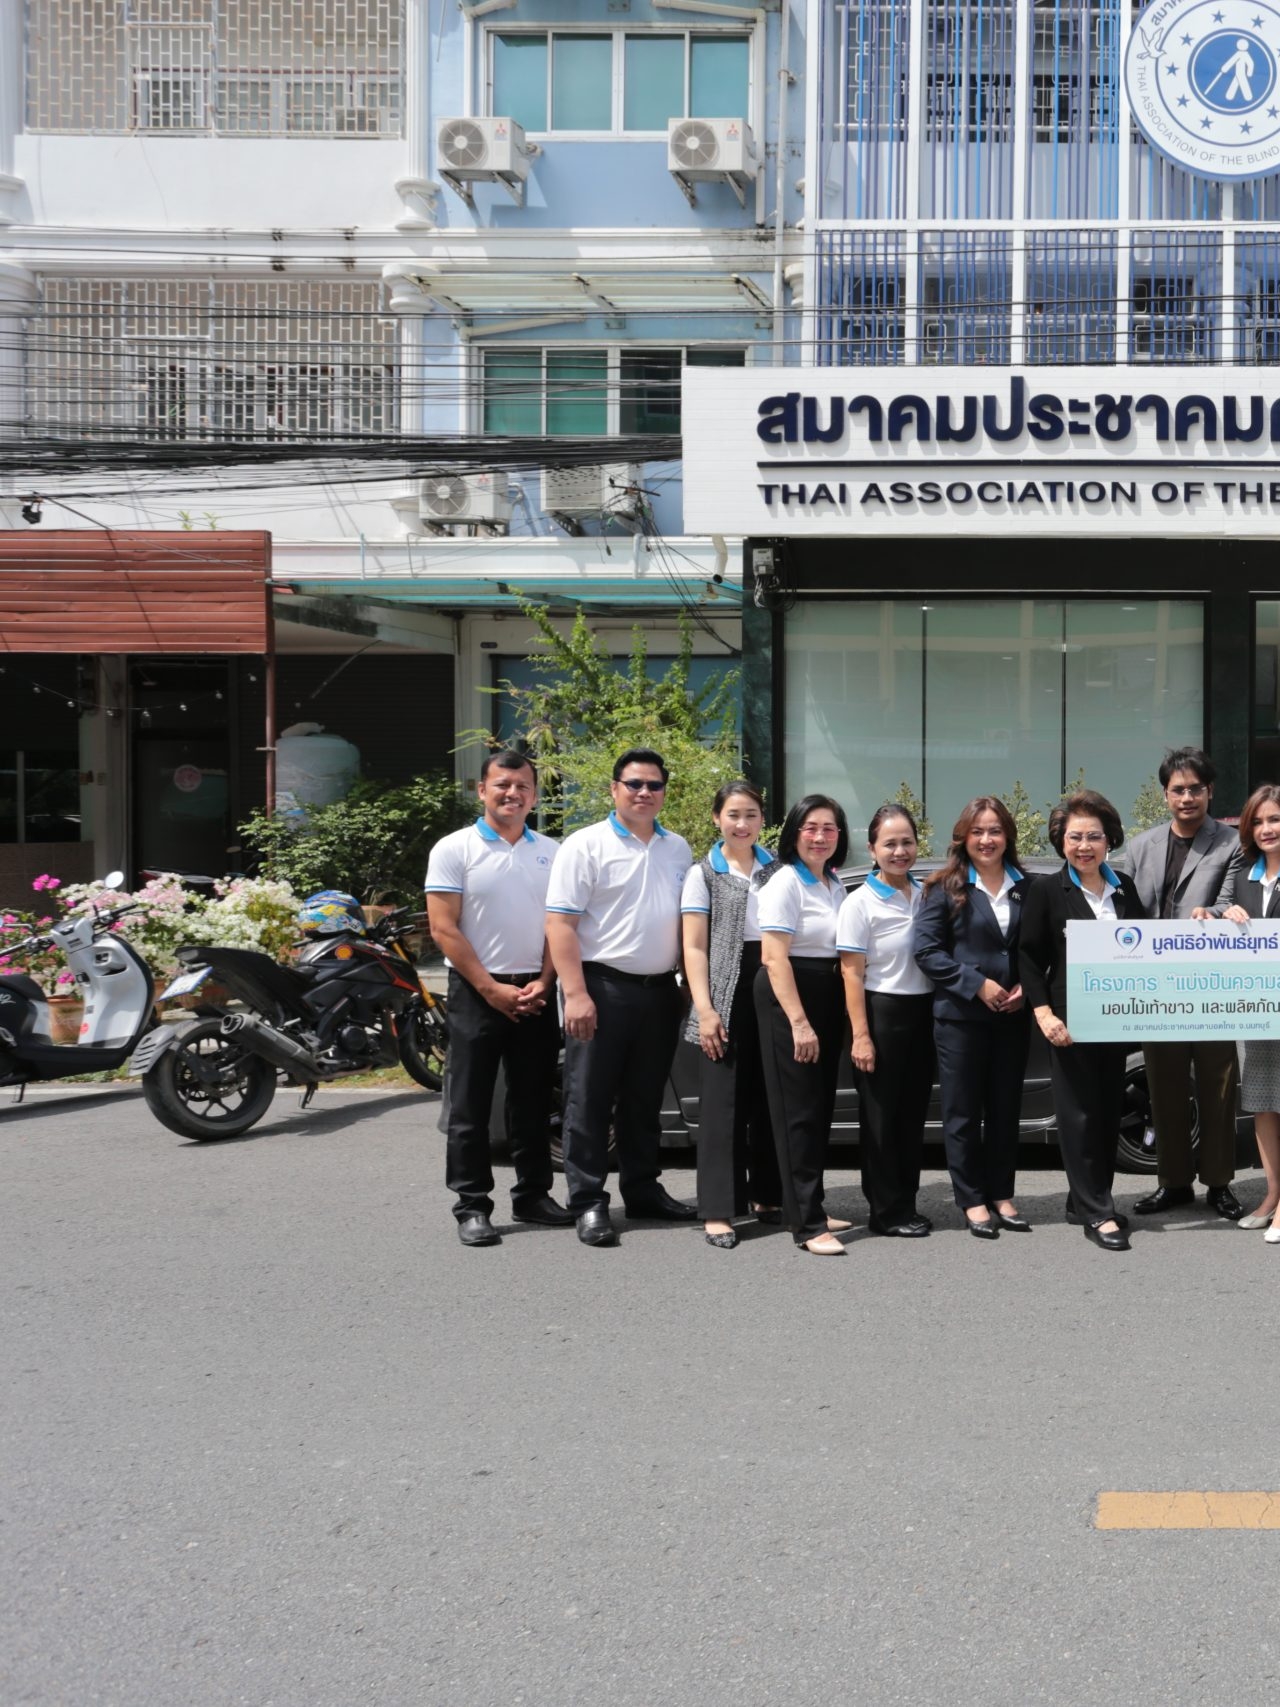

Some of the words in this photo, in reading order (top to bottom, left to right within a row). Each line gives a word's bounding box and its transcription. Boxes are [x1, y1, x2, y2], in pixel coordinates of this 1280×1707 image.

[1137, 66, 1148, 92] THAI
[1141, 96, 1197, 156] ASSOCIATION
[1200, 151, 1216, 162] OF
[1220, 155, 1243, 165] THE
[1247, 145, 1280, 164] BLIND
[757, 483, 847, 505] THAI
[860, 481, 1136, 504] ASSOCIATION
[1151, 481, 1205, 503] OF
[1152, 933, 1279, 955] มูลนิธิอำพันธ์ยุทธ์
[1083, 970, 1158, 993] โครงการ
[1101, 997, 1195, 1016] มอบไม้เท้าขาว
